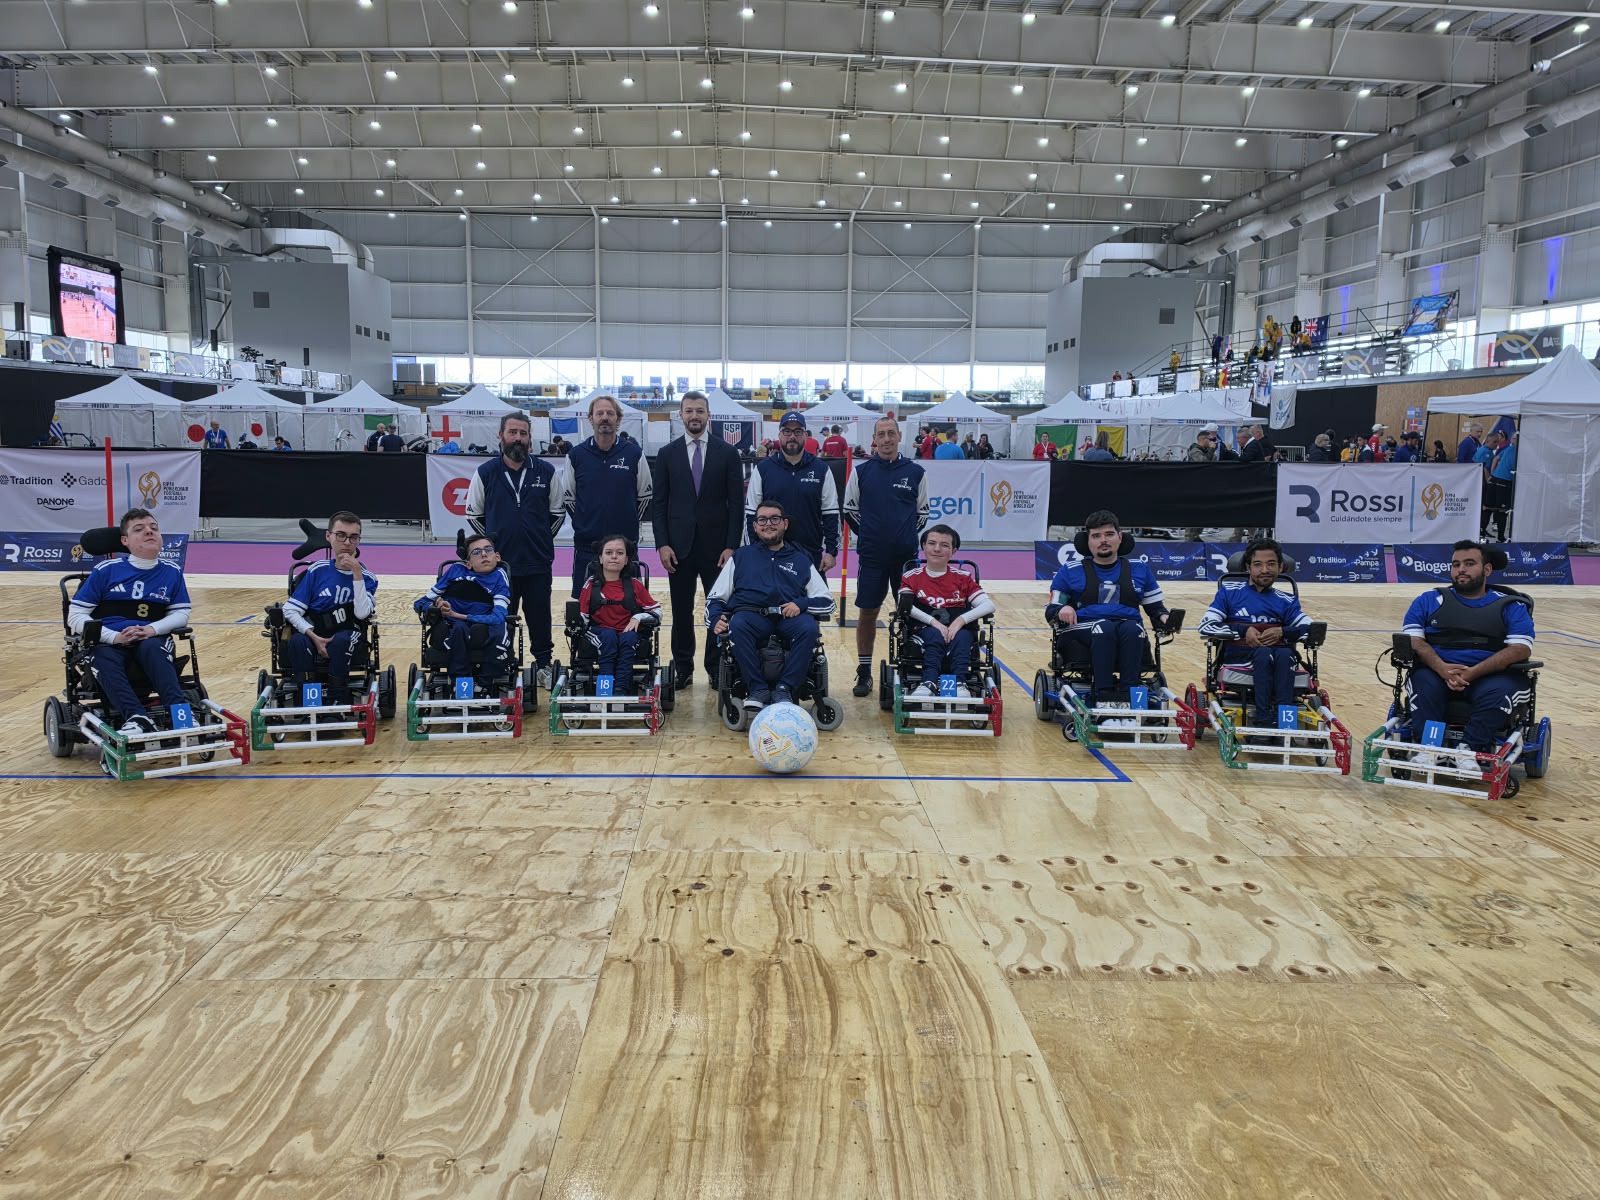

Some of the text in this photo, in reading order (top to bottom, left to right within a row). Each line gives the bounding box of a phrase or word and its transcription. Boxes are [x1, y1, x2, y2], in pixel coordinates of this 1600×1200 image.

[724, 423, 740, 433] USA
[10, 476, 53, 486] Tradition
[78, 476, 108, 487] Gado
[928, 495, 973, 521] gen
[1330, 515, 1403, 524] Cuidándote siempre
[1355, 559, 1380, 567] Pampa
[131, 580, 145, 600] 8
[333, 584, 351, 605] 10
[1103, 584, 1117, 604] 7
[136, 603, 149, 618] 8
[332, 607, 347, 621] 10
[461, 681, 469, 691] 9
[599, 679, 610, 690] 18
[941, 679, 955, 690] 22
[306, 688, 318, 700] 10
[1135, 691, 1143, 702] 7
[177, 708, 187, 721] 8
[1282, 710, 1294, 722] 13
[1429, 726, 1438, 739] 11
